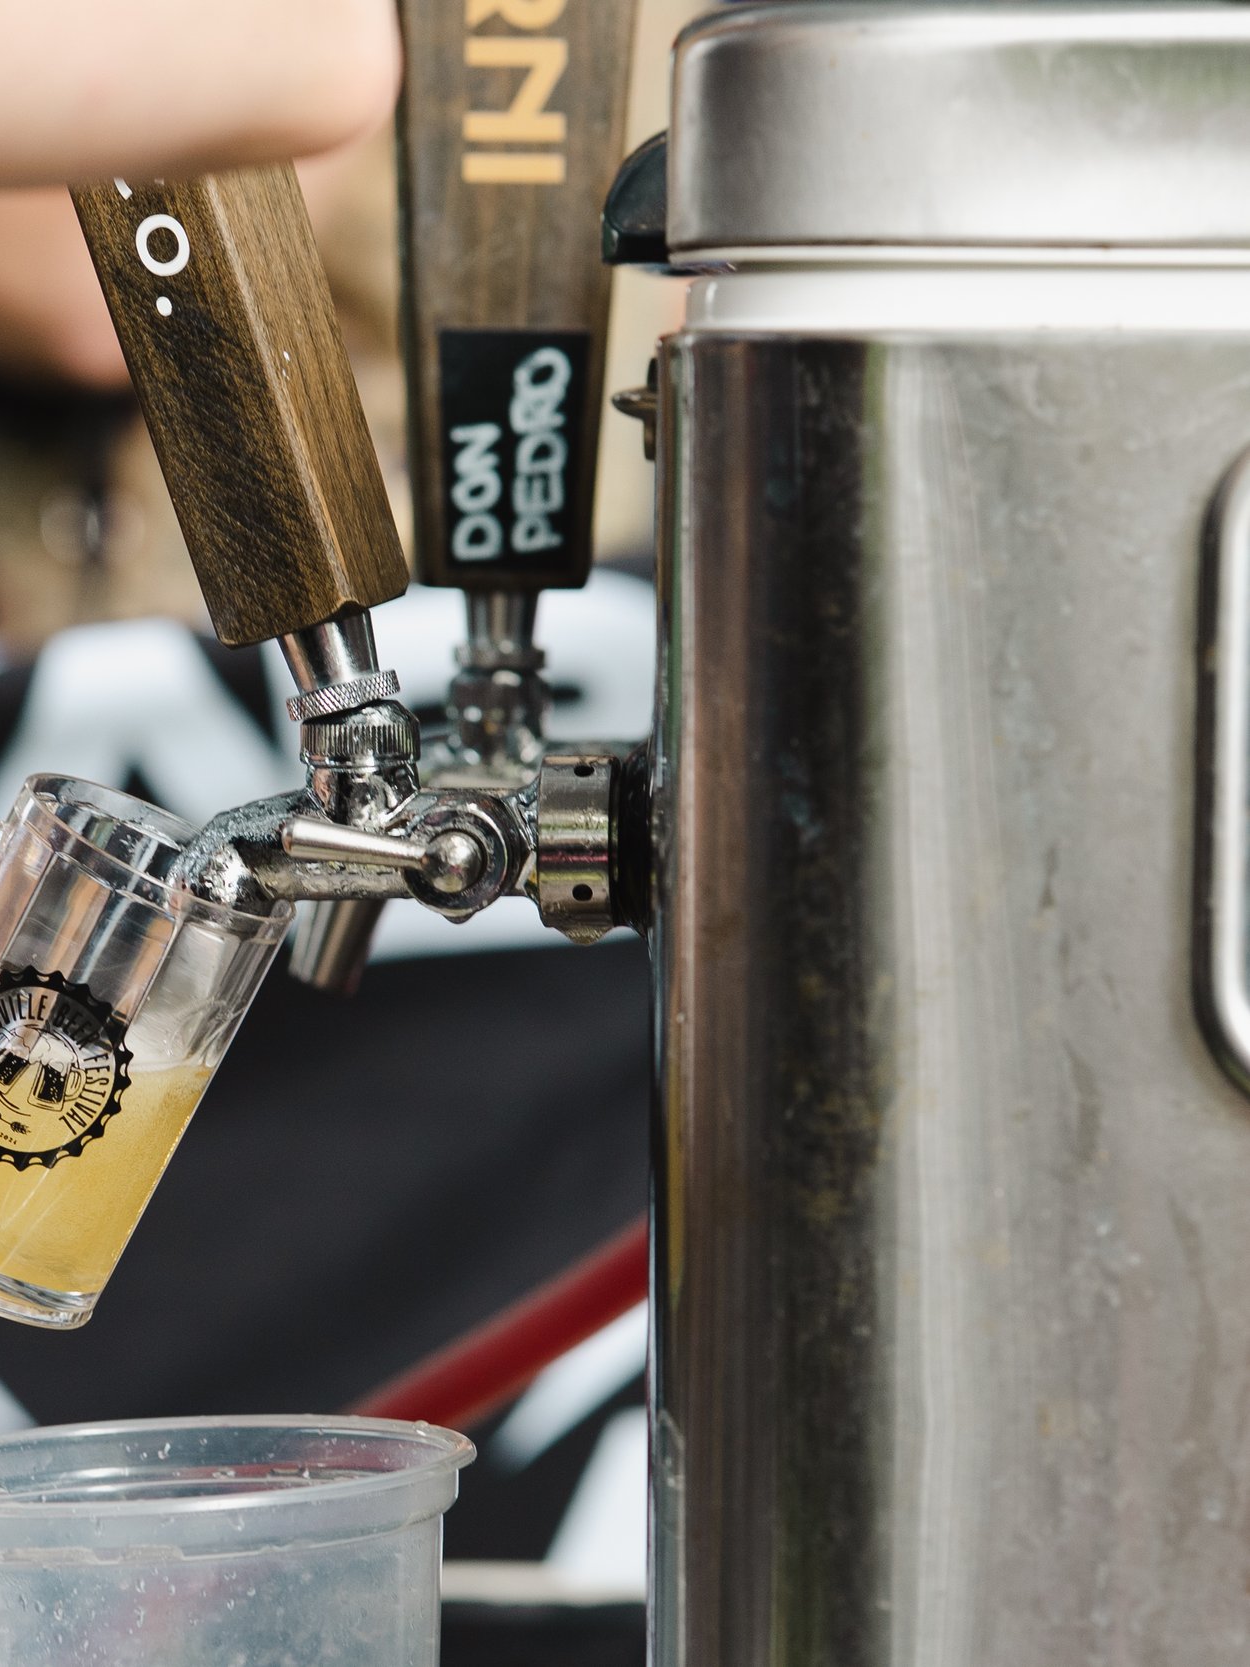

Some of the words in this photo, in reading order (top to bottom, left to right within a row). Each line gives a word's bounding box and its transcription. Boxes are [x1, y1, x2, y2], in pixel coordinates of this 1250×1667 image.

[450, 422, 502, 561] DON
[509, 347, 572, 552] PEDRO
[52, 1003, 100, 1050] BEER
[58, 1053, 110, 1135] FESTIVAL
